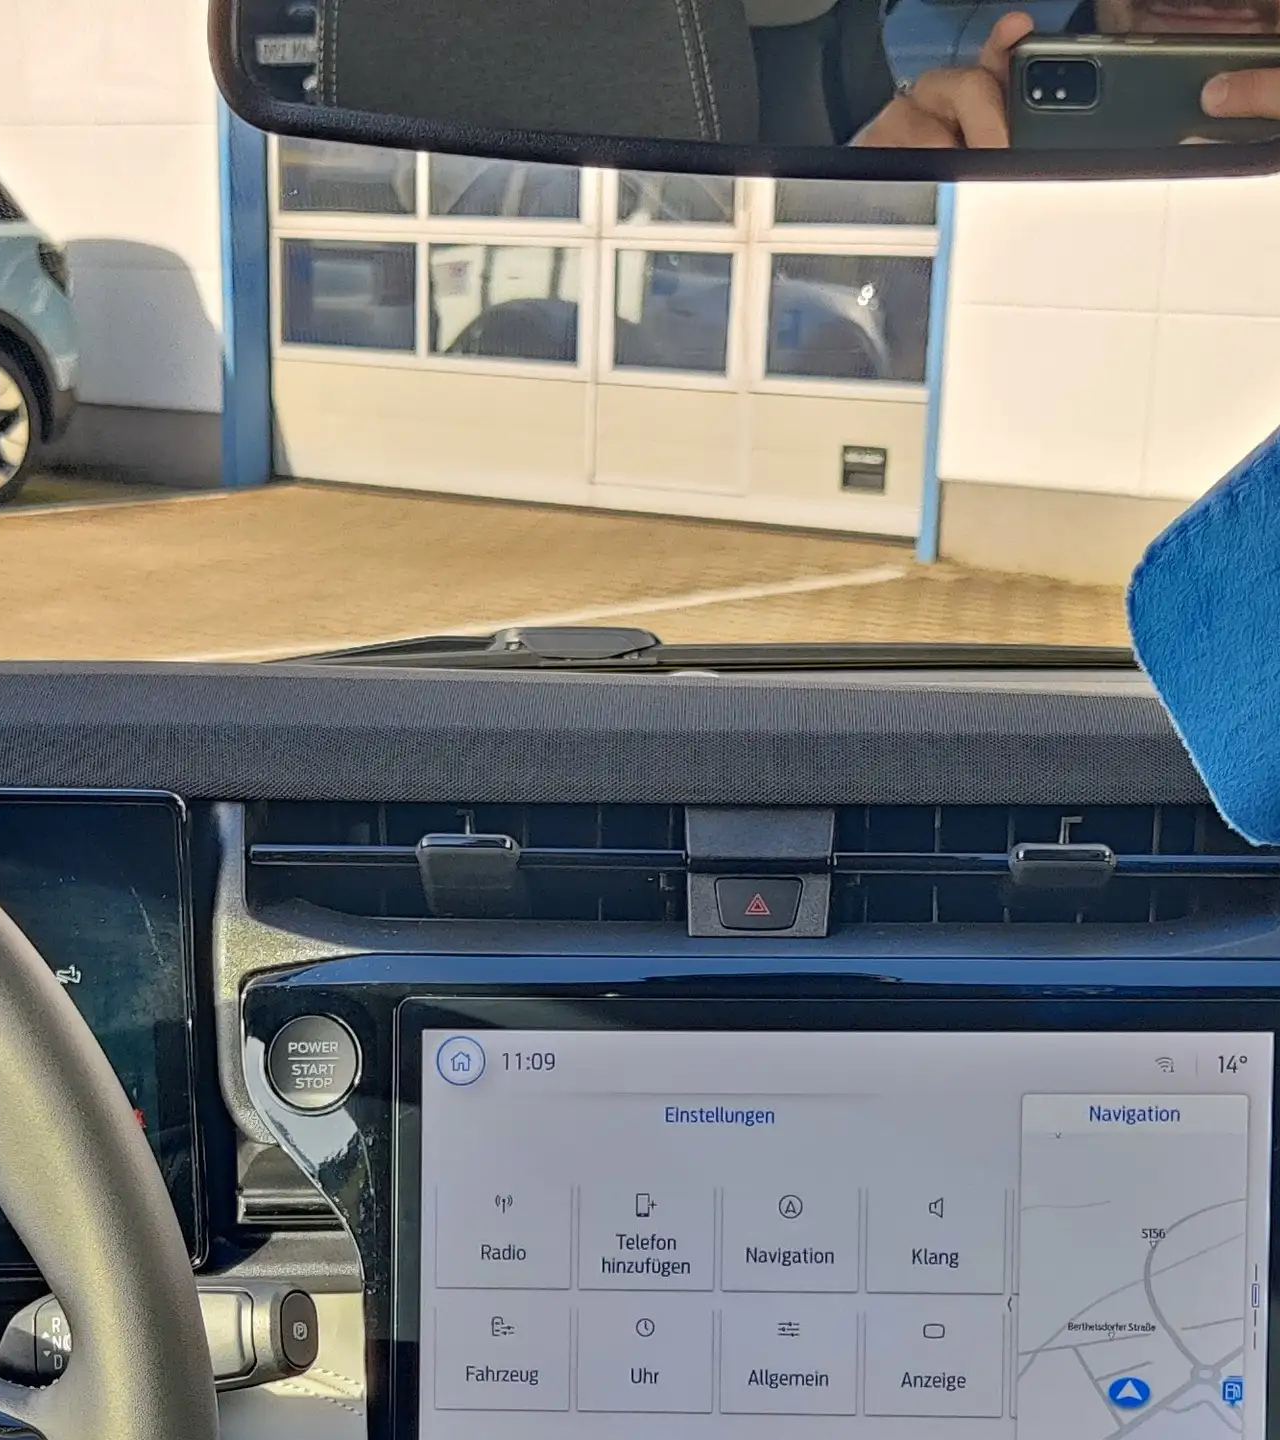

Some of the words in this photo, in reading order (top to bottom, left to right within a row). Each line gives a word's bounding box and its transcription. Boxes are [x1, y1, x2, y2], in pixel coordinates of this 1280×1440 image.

[288, 1042, 339, 1054] POWER
[291, 1064, 336, 1076] START
[502, 1052, 556, 1071] 11:09
[295, 1077, 333, 1089] STOP
[664, 1106, 775, 1127] Einstellungen
[1089, 1105, 1181, 1125] Navigation
[616, 1233, 677, 1251] Telefon
[480, 1244, 527, 1261] Radio
[746, 1247, 835, 1267] Navigation
[911, 1248, 960, 1268] Klang
[601, 1257, 691, 1277] hinzufügen
[51, 1317, 61, 1332] R
[52, 1336, 62, 1350] N
[53, 1354, 63, 1370] D
[465, 1365, 539, 1385] Fahrzeug
[630, 1367, 660, 1384] Uhr
[748, 1369, 829, 1389] Allgemein
[901, 1371, 967, 1392] Anzeige
